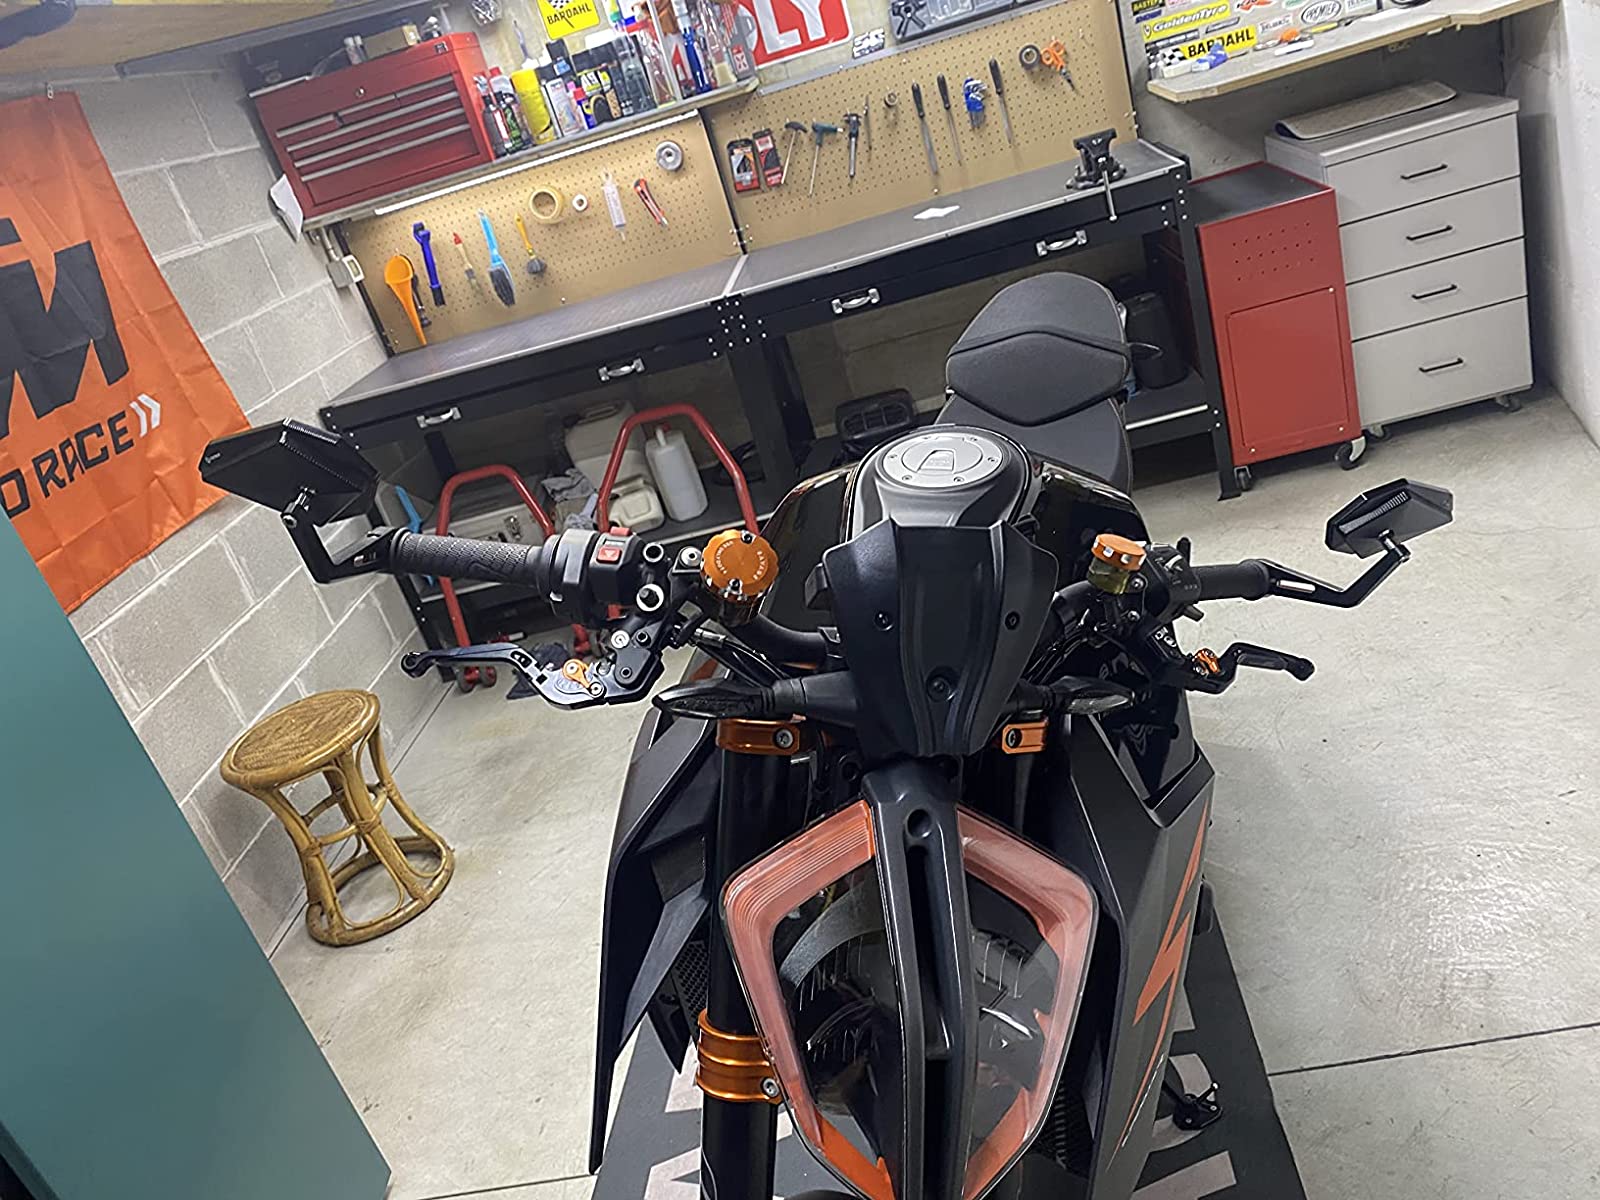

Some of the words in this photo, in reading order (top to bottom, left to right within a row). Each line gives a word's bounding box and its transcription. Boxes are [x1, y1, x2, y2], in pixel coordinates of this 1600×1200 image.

[546, 3, 592, 28] BARDAHL
[1305, 2, 1338, 21] PREMIER
[32, 411, 135, 498] RACE
